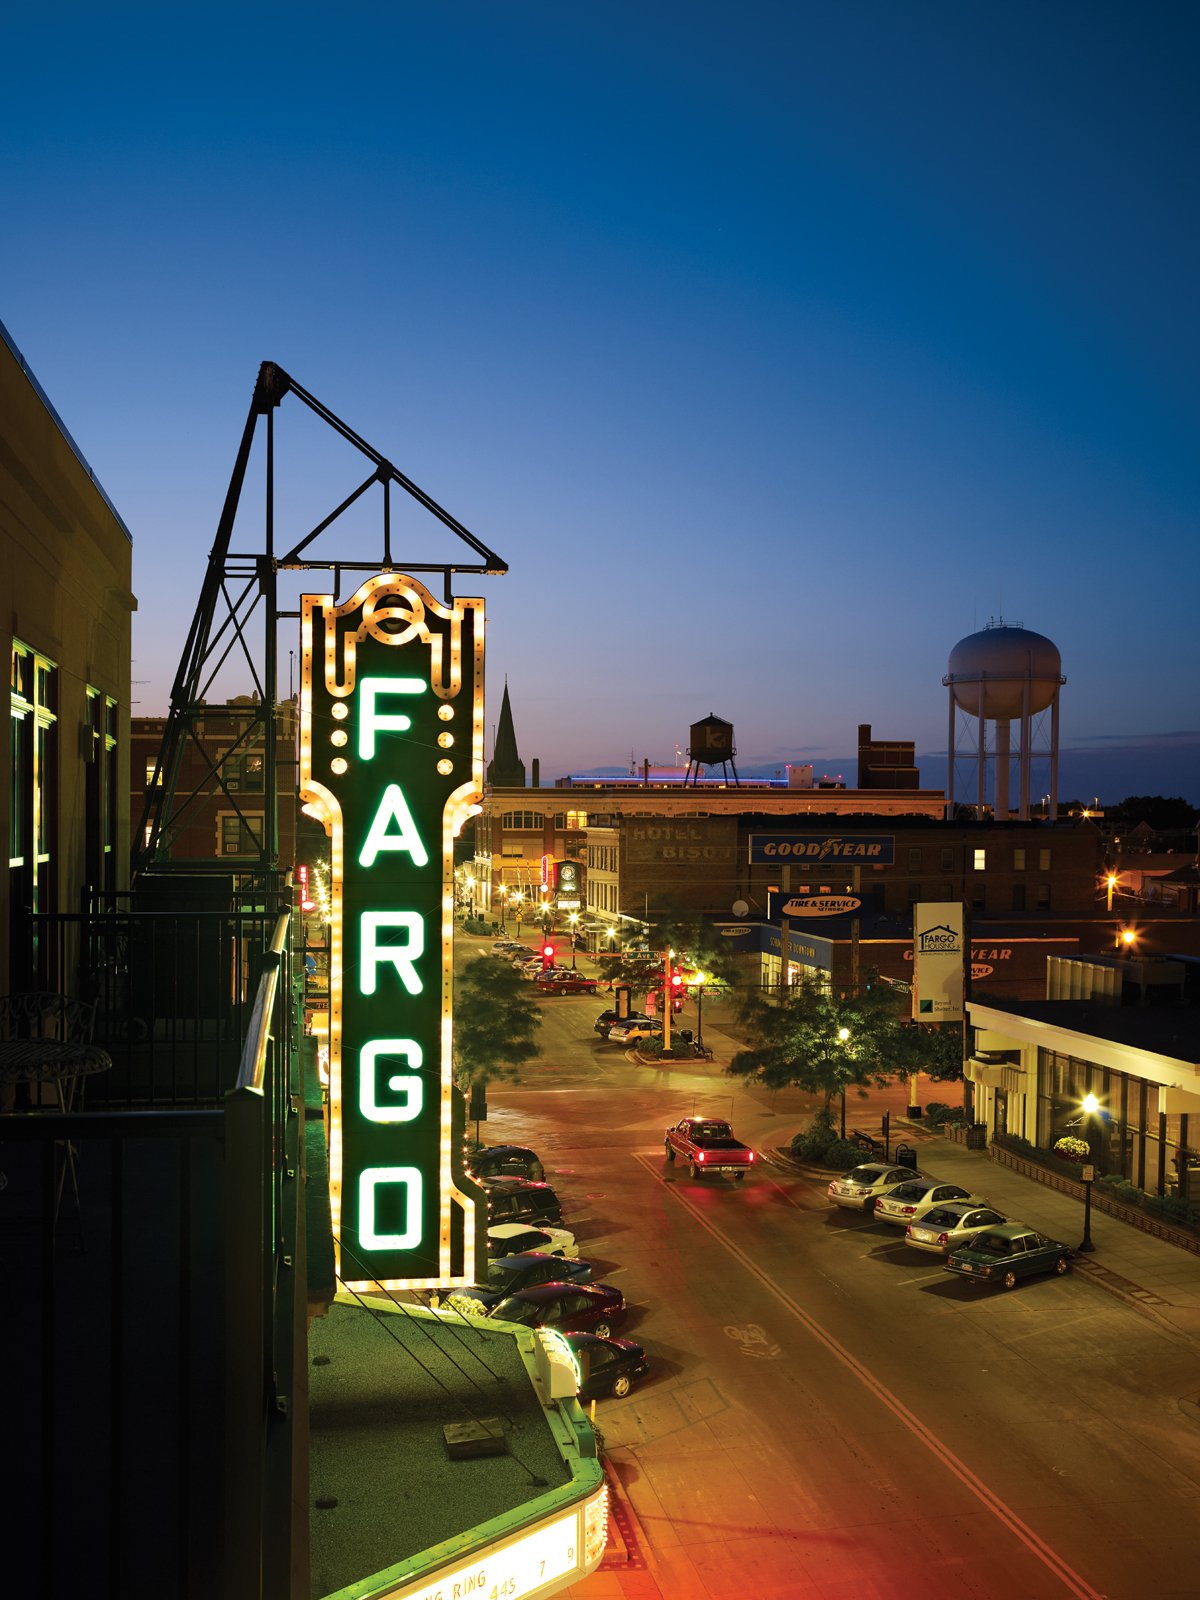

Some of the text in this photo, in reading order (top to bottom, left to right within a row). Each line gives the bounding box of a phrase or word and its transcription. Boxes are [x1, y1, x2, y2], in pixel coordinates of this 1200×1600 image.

[633, 827, 702, 840] HOTEL
[790, 900, 810, 908] TIRE
[819, 900, 857, 908] SERVICE
[924, 934, 955, 943] FARGO
[924, 942, 955, 950] HOUSING
[358, 677, 429, 1251] FARGO
[539, 1560, 546, 1577] 7
[453, 1570, 486, 1600] RING
